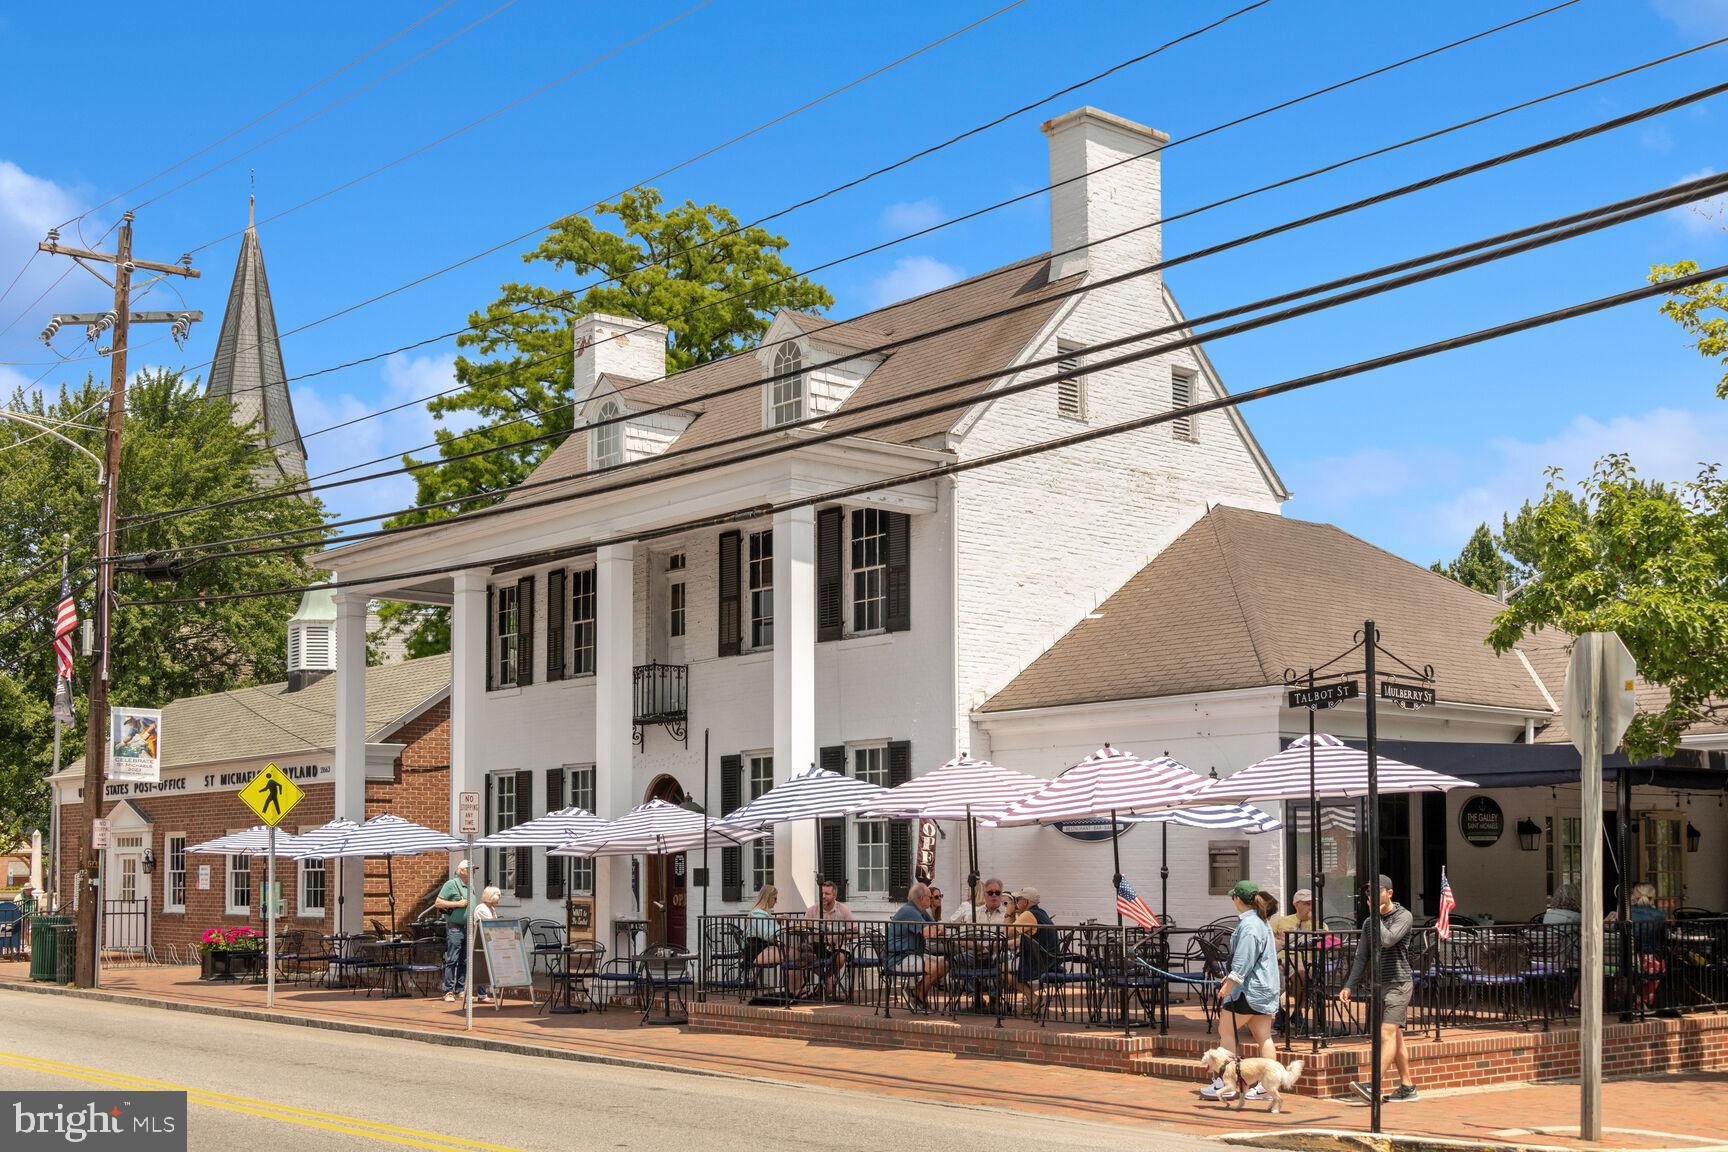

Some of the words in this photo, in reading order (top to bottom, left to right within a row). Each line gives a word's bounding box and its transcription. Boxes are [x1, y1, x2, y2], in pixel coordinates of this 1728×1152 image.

[1294, 689, 1334, 704] TALBOT
[1337, 686, 1350, 697] ST
[1384, 685, 1423, 701] MULBERRY
[1424, 691, 1433, 702] ST
[106, 784, 129, 796] STATES
[134, 778, 186, 793] POST-OFFICE
[204, 775, 215, 787] ST
[220, 769, 261, 785] MICHAEL
[1467, 813, 1478, 822] THE
[1478, 813, 1498, 822] GALLEY
[920, 822, 936, 880] OPEN
